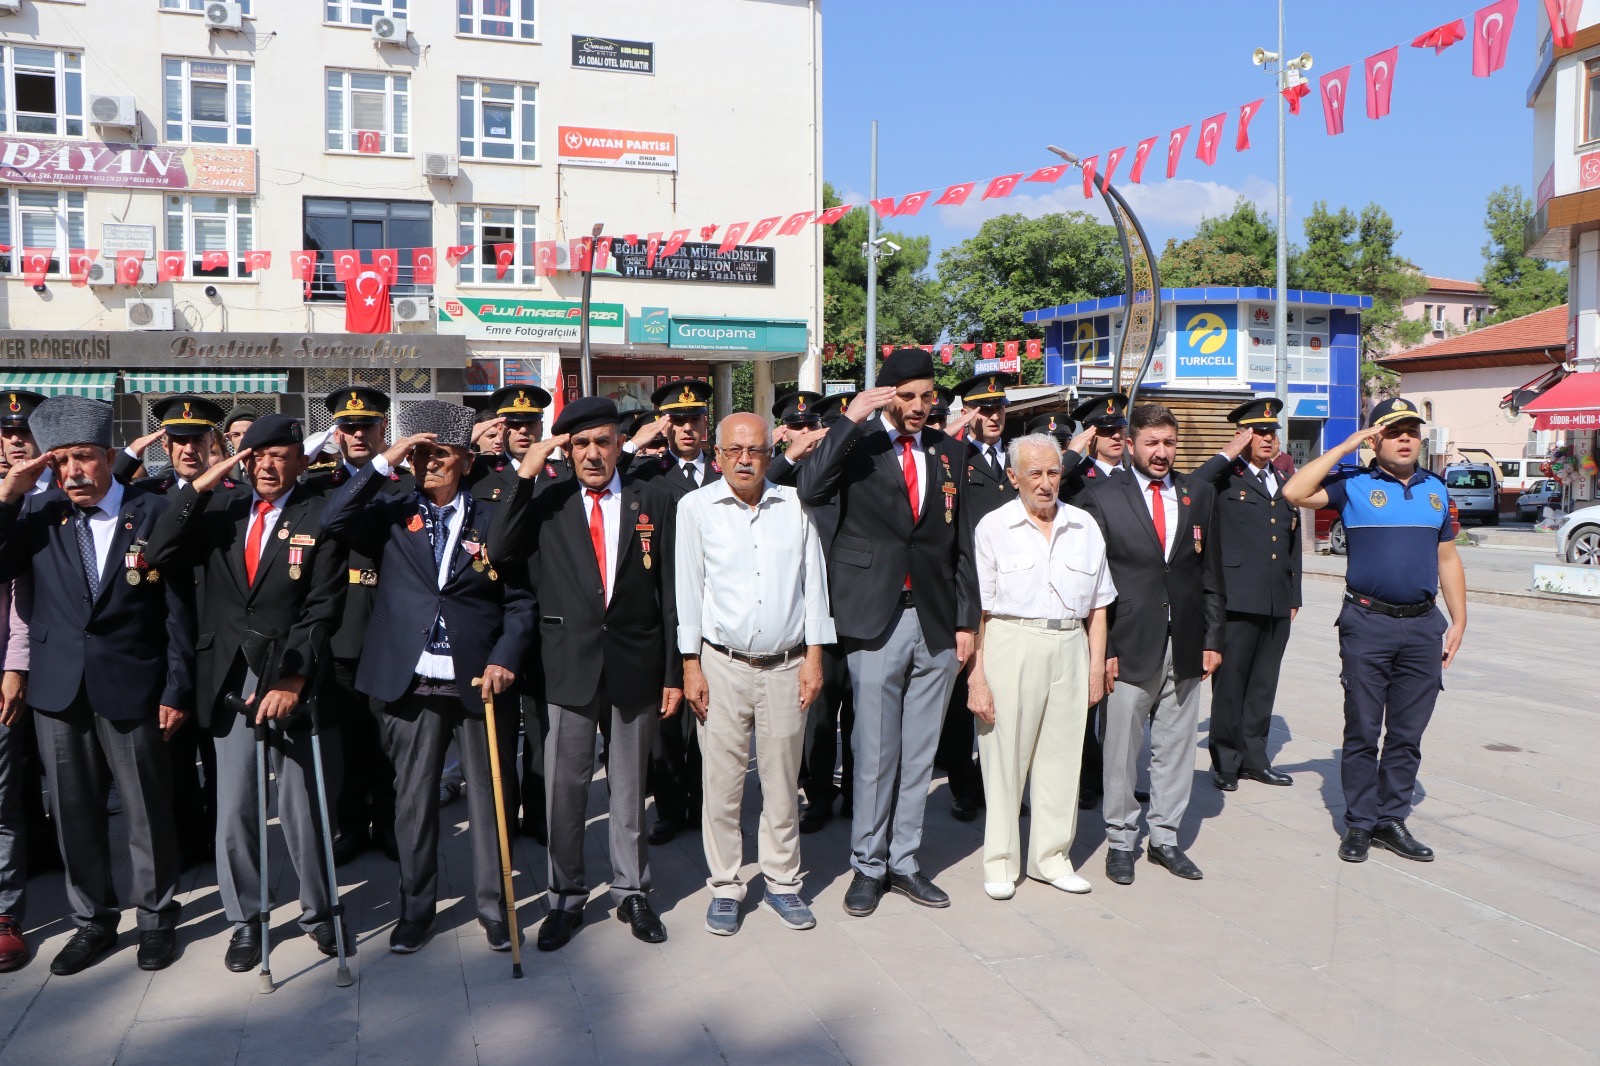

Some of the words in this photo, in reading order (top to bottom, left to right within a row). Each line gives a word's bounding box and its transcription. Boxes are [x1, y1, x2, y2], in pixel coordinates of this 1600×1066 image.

[578, 55, 586, 65] 24
[586, 56, 603, 67] ODALI
[604, 58, 618, 68] OTEL
[619, 59, 649, 71] SATILIKTIR
[583, 136, 623, 149] VATAN
[626, 139, 671, 152] PARTİSİ
[1, 141, 173, 176] DAYAN
[654, 257, 691, 269] HAZIR
[694, 260, 731, 271] BETON
[626, 267, 653, 276] Plan
[666, 268, 698, 279] Proje
[710, 271, 757, 281] Taahhüt
[566, 308, 618, 320] PAZA
[486, 325, 512, 335] Emre
[515, 326, 577, 339] Fotoğrafçılık
[678, 324, 756, 341] Groupama
[30, 333, 111, 365] BÖREKÇİSİ
[170, 336, 286, 363] Baştürk
[292, 337, 421, 364] Sarrafiye
[975, 361, 998, 373] ŞİMŞEK
[1000, 360, 1016, 370] BÜFE
[1179, 356, 1234, 366] TURKCELL
[1250, 363, 1272, 372] Casper
